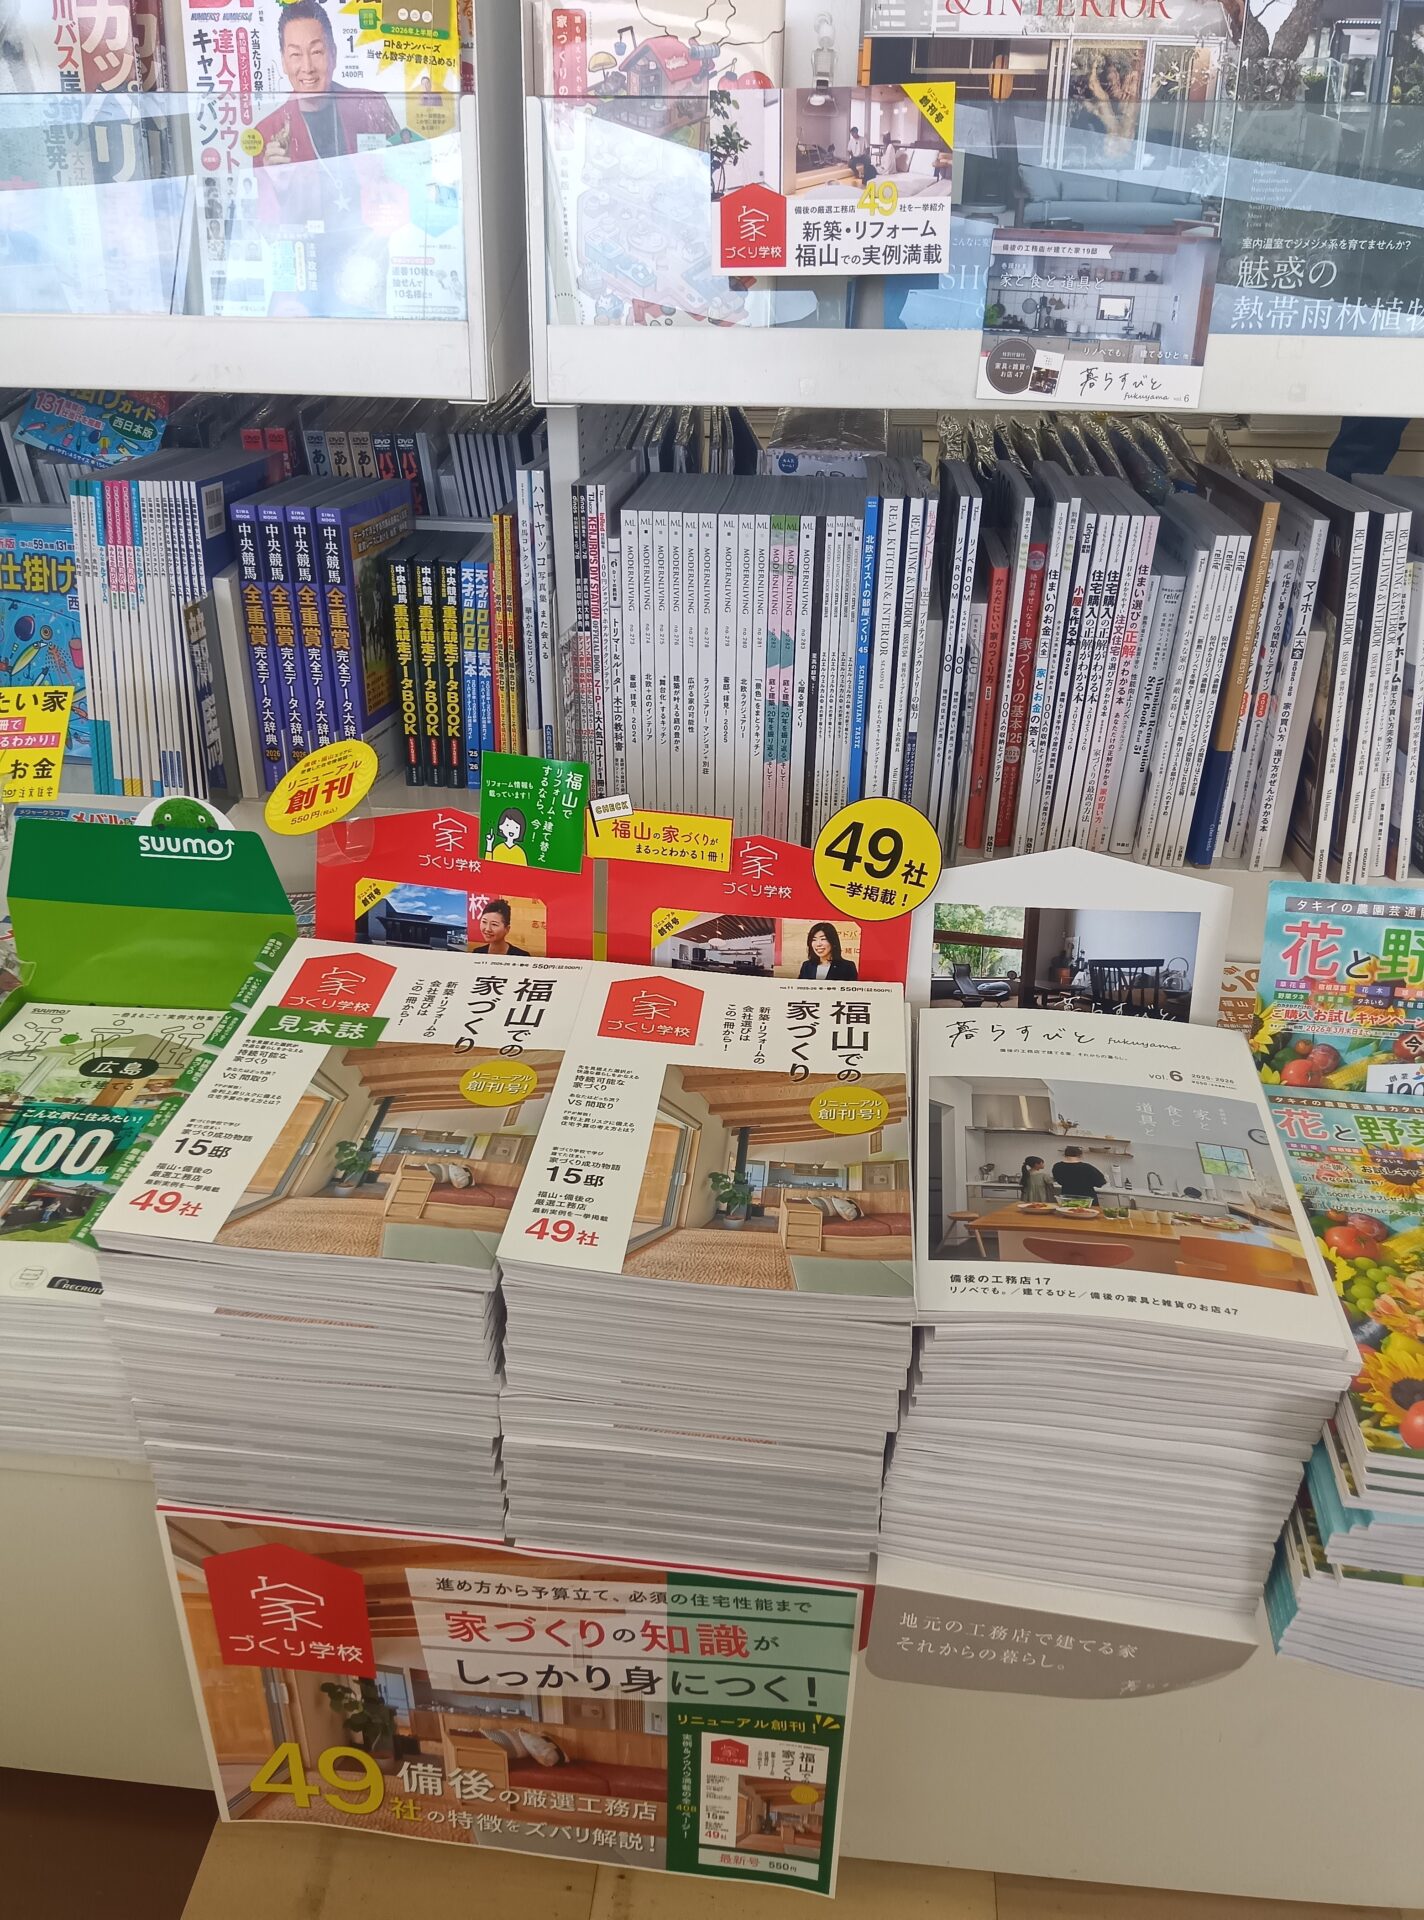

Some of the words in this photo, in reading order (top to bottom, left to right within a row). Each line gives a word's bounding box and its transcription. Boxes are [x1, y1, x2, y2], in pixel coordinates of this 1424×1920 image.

[192, 29, 219, 146] キャラバン
[213, 29, 240, 174] 達人スカウト
[918, 95, 945, 124] 創刊号
[857, 181, 899, 216] 49
[802, 219, 937, 242] 新築・リフォーム
[725, 246, 782, 259] づくり学校
[794, 243, 942, 267] 福山での実例満載
[1235, 255, 1337, 290] 魅惑の
[533, 486, 547, 567] ハヤヤッコ
[888, 505, 898, 535] REAL
[884, 538, 896, 590] KITCHEN
[590, 583, 600, 620] STATION
[860, 535, 875, 643] 北欧テイストの部屋づくり
[1041, 570, 1060, 637] 住まいのお金
[1065, 585, 1085, 647] 小屋を作る本
[879, 602, 892, 656] INTERIOR
[11, 760, 56, 780] お金
[288, 760, 363, 791] リニューアル
[285, 772, 355, 815] 創刊
[486, 779, 534, 790] リフォーム情報も
[488, 790, 531, 800] 載っています!
[561, 770, 584, 820] 福山で
[537, 768, 564, 863] リフォーム・建て替え
[595, 800, 629, 815] CHECK
[611, 818, 719, 846] 福山の家づくりが
[418, 854, 482, 873] づくり学校
[635, 843, 724, 863] まるっとわかる1冊!
[825, 821, 930, 888] 49社
[361, 886, 382, 908] 創刊号
[722, 882, 793, 900] づくり学校
[829, 881, 909, 908] 一挙掲載!
[657, 917, 681, 938] 創刊号
[285, 995, 372, 1014] づくり学校
[397, 978, 425, 1026] この一冊から!
[416, 979, 442, 1017] 会社選びは
[423, 980, 459, 1038] 新築・リフォームの
[268, 1014, 370, 1041] 見本誌
[453, 976, 508, 1056] 家づくり
[498, 977, 558, 1058] 福山での
[606, 1019, 692, 1038] づくり学校
[722, 1003, 737, 1052] この一冊から!
[739, 1005, 755, 1042] 会社選びは
[753, 1005, 771, 1064] 新築・リフォームの
[786, 1000, 820, 1083] 家づくり
[830, 1001, 871, 1083] 福山での
[91, 1061, 152, 1076] 広島
[233, 1055, 268, 1066] 家づくり
[236, 1049, 288, 1060] 持続可能な
[222, 1072, 237, 1080] VS
[240, 1074, 268, 1083] 間取り
[466, 1079, 530, 1095] 創刊号!
[470, 1070, 532, 1083] リニューアル
[572, 1081, 608, 1092] 家づくり
[574, 1074, 626, 1086] 持続可能な
[21, 1108, 143, 1125] こんな家に住みたい!
[567, 1099, 582, 1107] VS
[585, 1100, 614, 1110] 間取り
[817, 1108, 882, 1121] 創刊号!
[818, 1099, 882, 1109] リニューアル
[174, 1137, 232, 1159] 15邸
[180, 1128, 254, 1142] 家づくり成功物語
[546, 1165, 605, 1188] 15邸
[548, 1156, 621, 1171] 家づくり成功物語
[128, 1188, 203, 1217] 49社
[534, 1198, 588, 1211] 厳選工務店
[536, 1190, 595, 1204] 福山・備後の
[531, 1207, 609, 1222] 最新実例を一挙掲載
[524, 1217, 600, 1247] 49社
[435, 1576, 813, 1614] 進め方から予算立て、必須の住宅性能まで
[444, 1610, 780, 1658] 家づくりの知識が
[899, 1611, 1139, 1659] 地元の工務店で建てる家
[228, 1634, 364, 1664] づくり学校
[896, 1636, 1066, 1672] それからの暮らし。
[456, 1658, 818, 1708] しっかり身につく!
[677, 1714, 818, 1734] リニューアル創刊!
[397, 1760, 657, 1822] 備後の厳選工務店
[720, 1853, 760, 1868] 最新号
